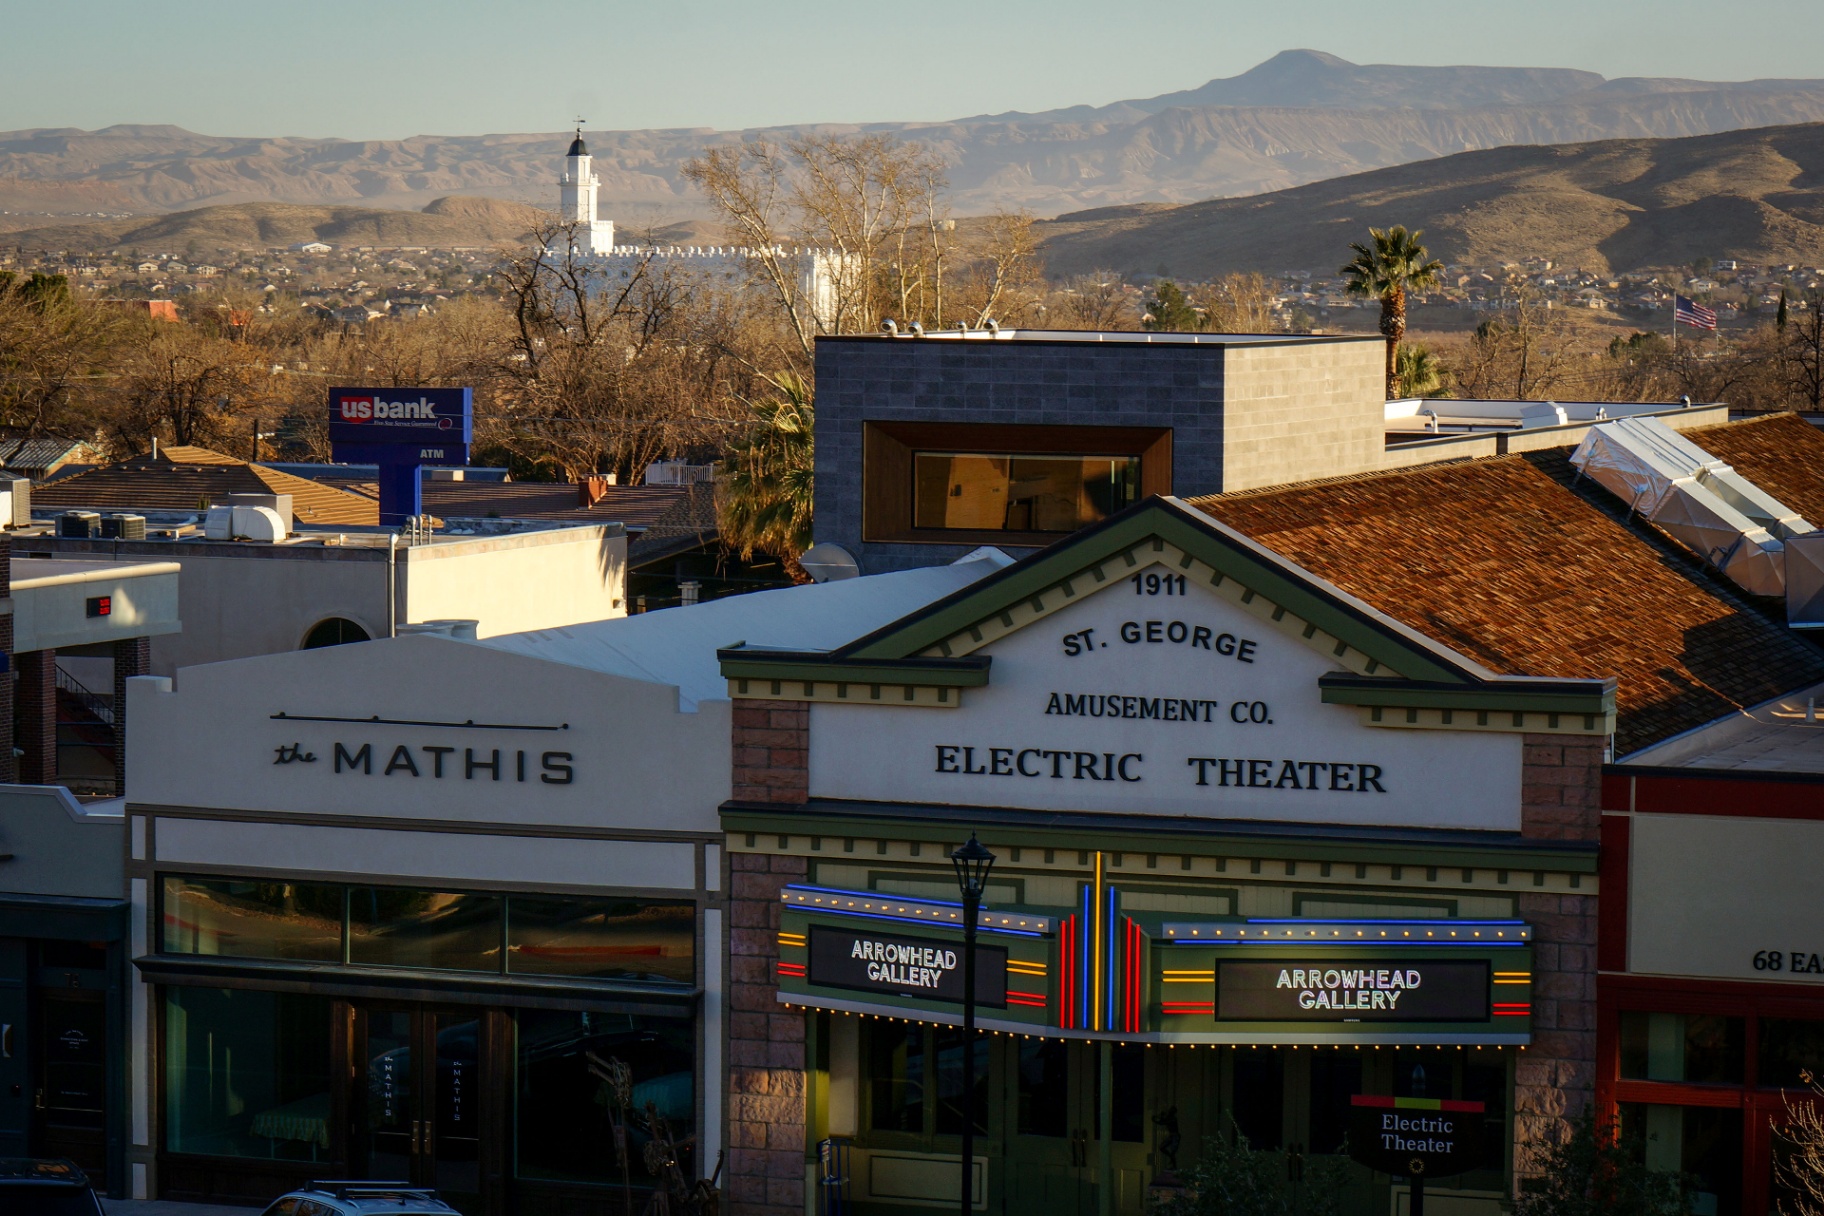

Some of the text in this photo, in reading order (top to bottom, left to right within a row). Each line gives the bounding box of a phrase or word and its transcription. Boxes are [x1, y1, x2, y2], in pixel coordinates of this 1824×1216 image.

[420, 449, 444, 459] ATM
[1131, 573, 1186, 596] 1911
[1062, 620, 1258, 664] ST. GEORGE
[1044, 692, 1274, 725] AMUSEMENT CO.
[273, 742, 573, 785] the MATHIS
[934, 744, 1387, 793] ELECTRIC THEATER
[851, 939, 957, 970] ARROWHEAD
[1753, 950, 1824, 974] 68 EA
[867, 961, 942, 988] GALLERY
[1276, 969, 1421, 989] ARROWHEAD
[1299, 990, 1401, 1010] GALLERY
[1381, 1113, 1454, 1133] Electric
[1381, 1134, 1454, 1154] Theater
